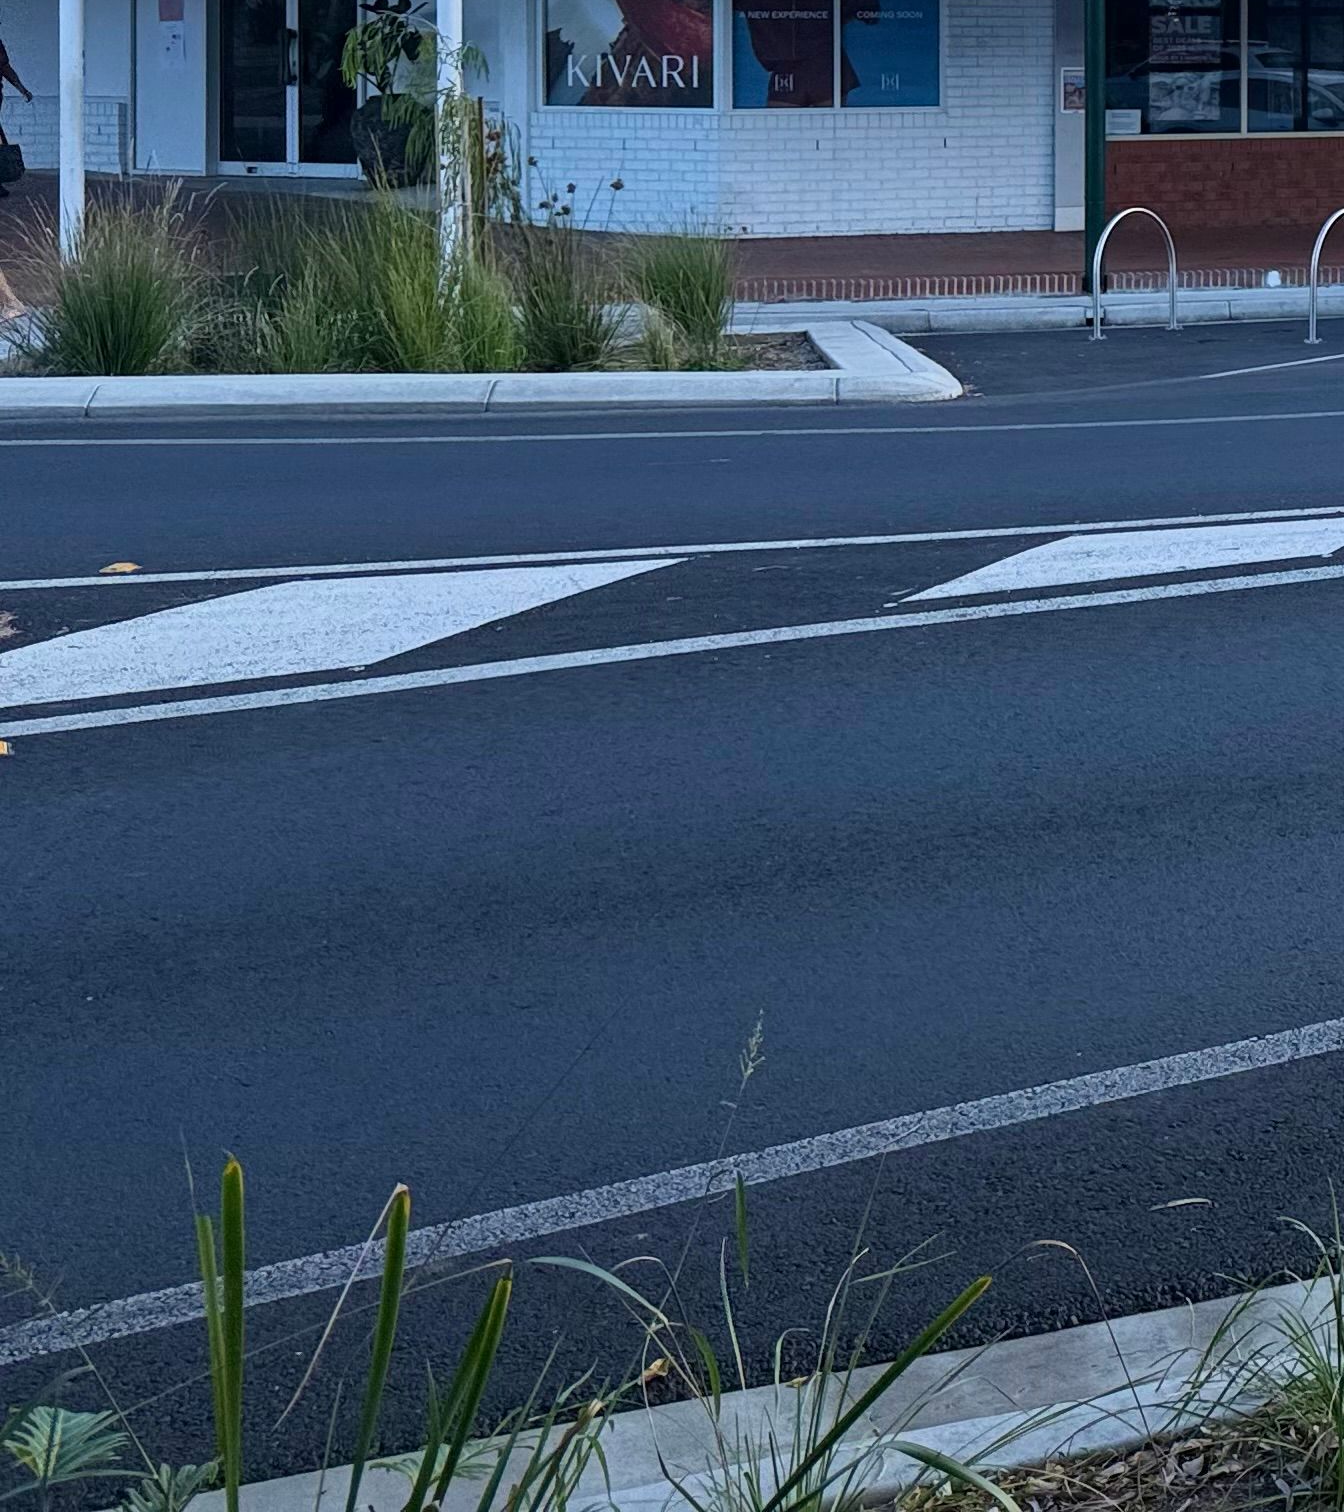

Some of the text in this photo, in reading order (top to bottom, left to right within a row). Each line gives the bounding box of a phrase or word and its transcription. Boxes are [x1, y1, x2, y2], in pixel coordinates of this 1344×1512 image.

[748, 10, 771, 20] NEW
[771, 10, 830, 20] EXPERIENCE
[855, 10, 924, 20] COMING SOON
[1151, 15, 1213, 34] SALE
[566, 53, 699, 90] KIVARI
